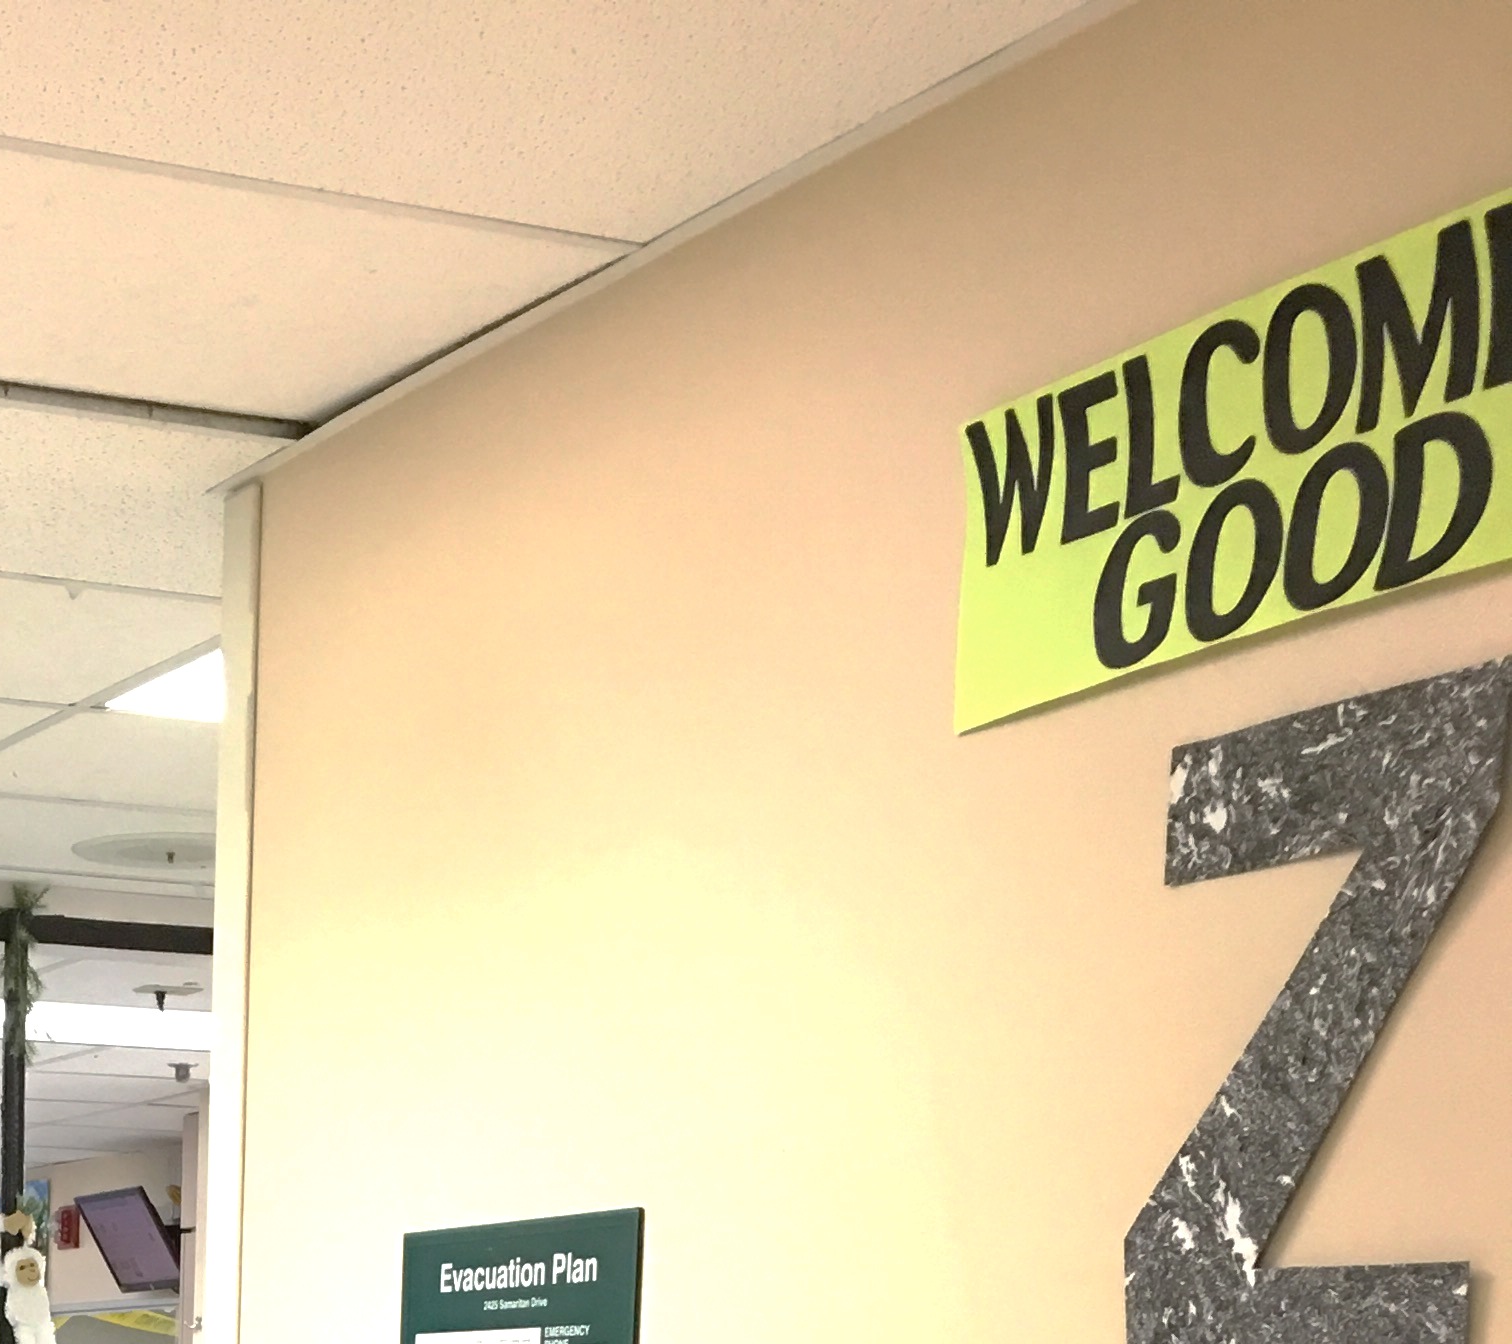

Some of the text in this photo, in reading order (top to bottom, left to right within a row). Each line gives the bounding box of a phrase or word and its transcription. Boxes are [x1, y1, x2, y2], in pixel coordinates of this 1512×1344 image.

[1093, 411, 1494, 669] GOOD
[440, 1252, 598, 1294] Evacuation Plan
[499, 1298, 530, 1310] Samaritan
[531, 1297, 548, 1308] Drive
[544, 1324, 591, 1338] EMERGENCY
